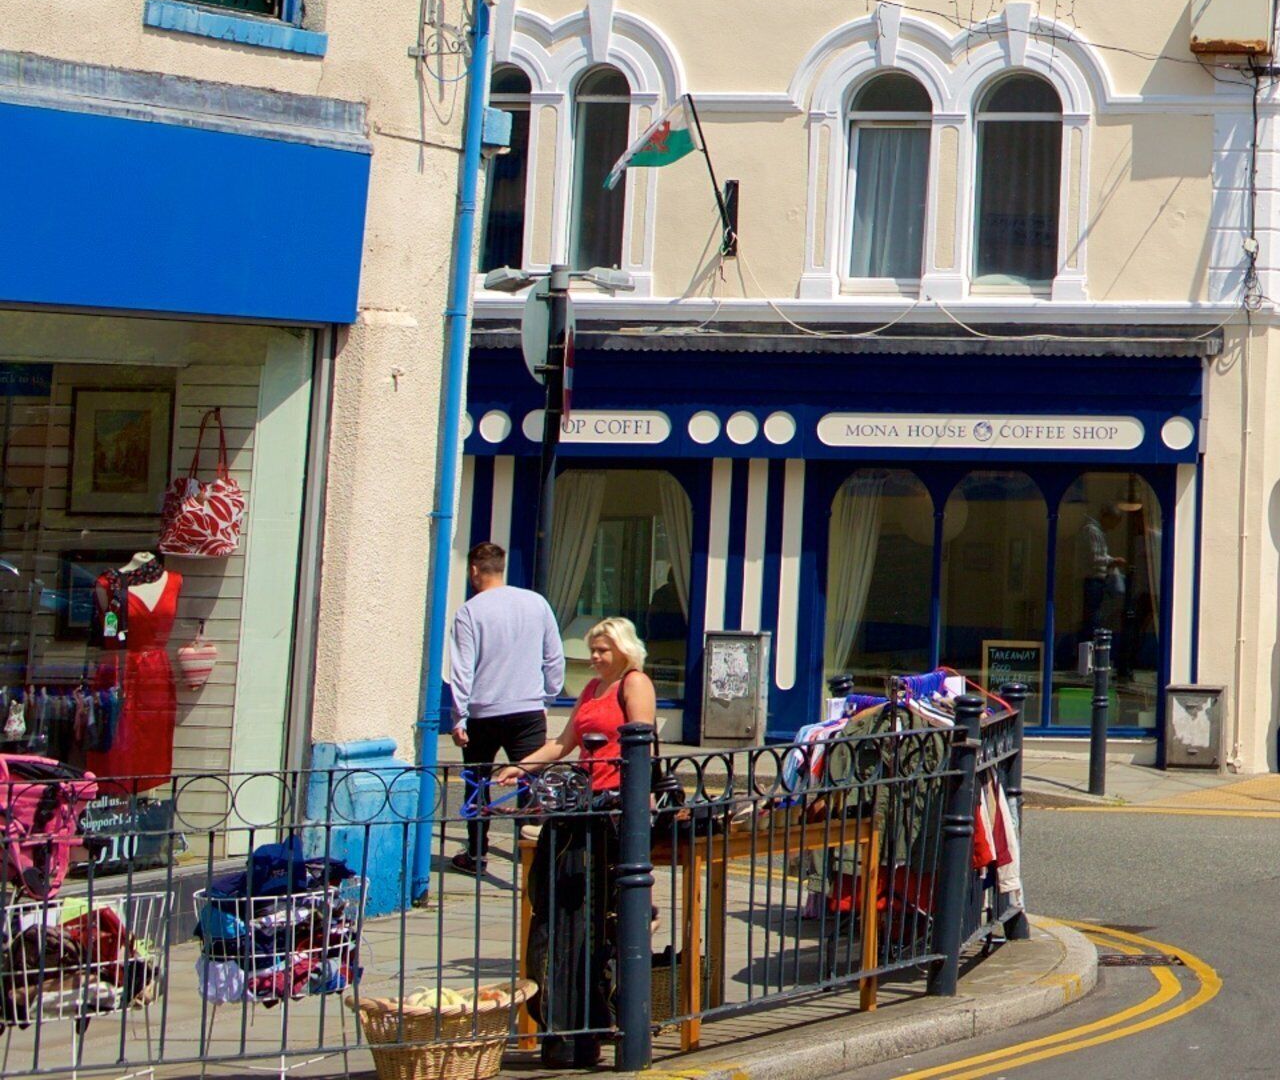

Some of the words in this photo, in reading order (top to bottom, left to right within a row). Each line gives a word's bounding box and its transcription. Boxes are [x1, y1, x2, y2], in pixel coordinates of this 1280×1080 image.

[594, 420, 652, 435] COFFI
[845, 424, 899, 437] MONA
[907, 425, 967, 438] HOUSE
[999, 425, 1066, 439] COFFEE
[1072, 426, 1119, 440] SHOP
[989, 648, 1037, 661] TAKEAWAY
[91, 795, 109, 809] call
[80, 816, 117, 832] Support
